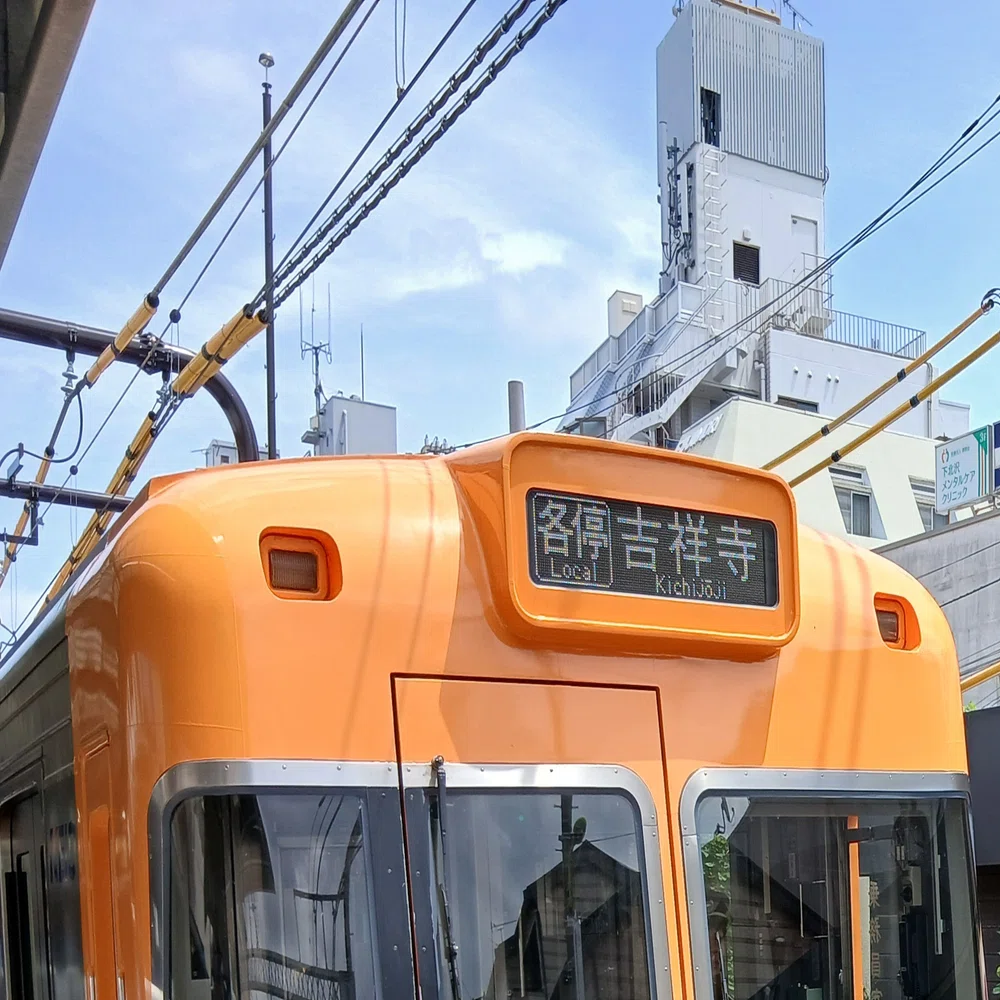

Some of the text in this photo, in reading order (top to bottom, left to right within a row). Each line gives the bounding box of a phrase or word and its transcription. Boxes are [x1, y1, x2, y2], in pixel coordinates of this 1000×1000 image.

[979, 432, 987, 443] 3F
[942, 461, 960, 478] 下北沢
[942, 470, 976, 492] メンタルケア
[942, 486, 968, 505] クリニック
[537, 499, 609, 560] 各停
[616, 505, 757, 581] 吉祥寺
[550, 556, 597, 582] Local
